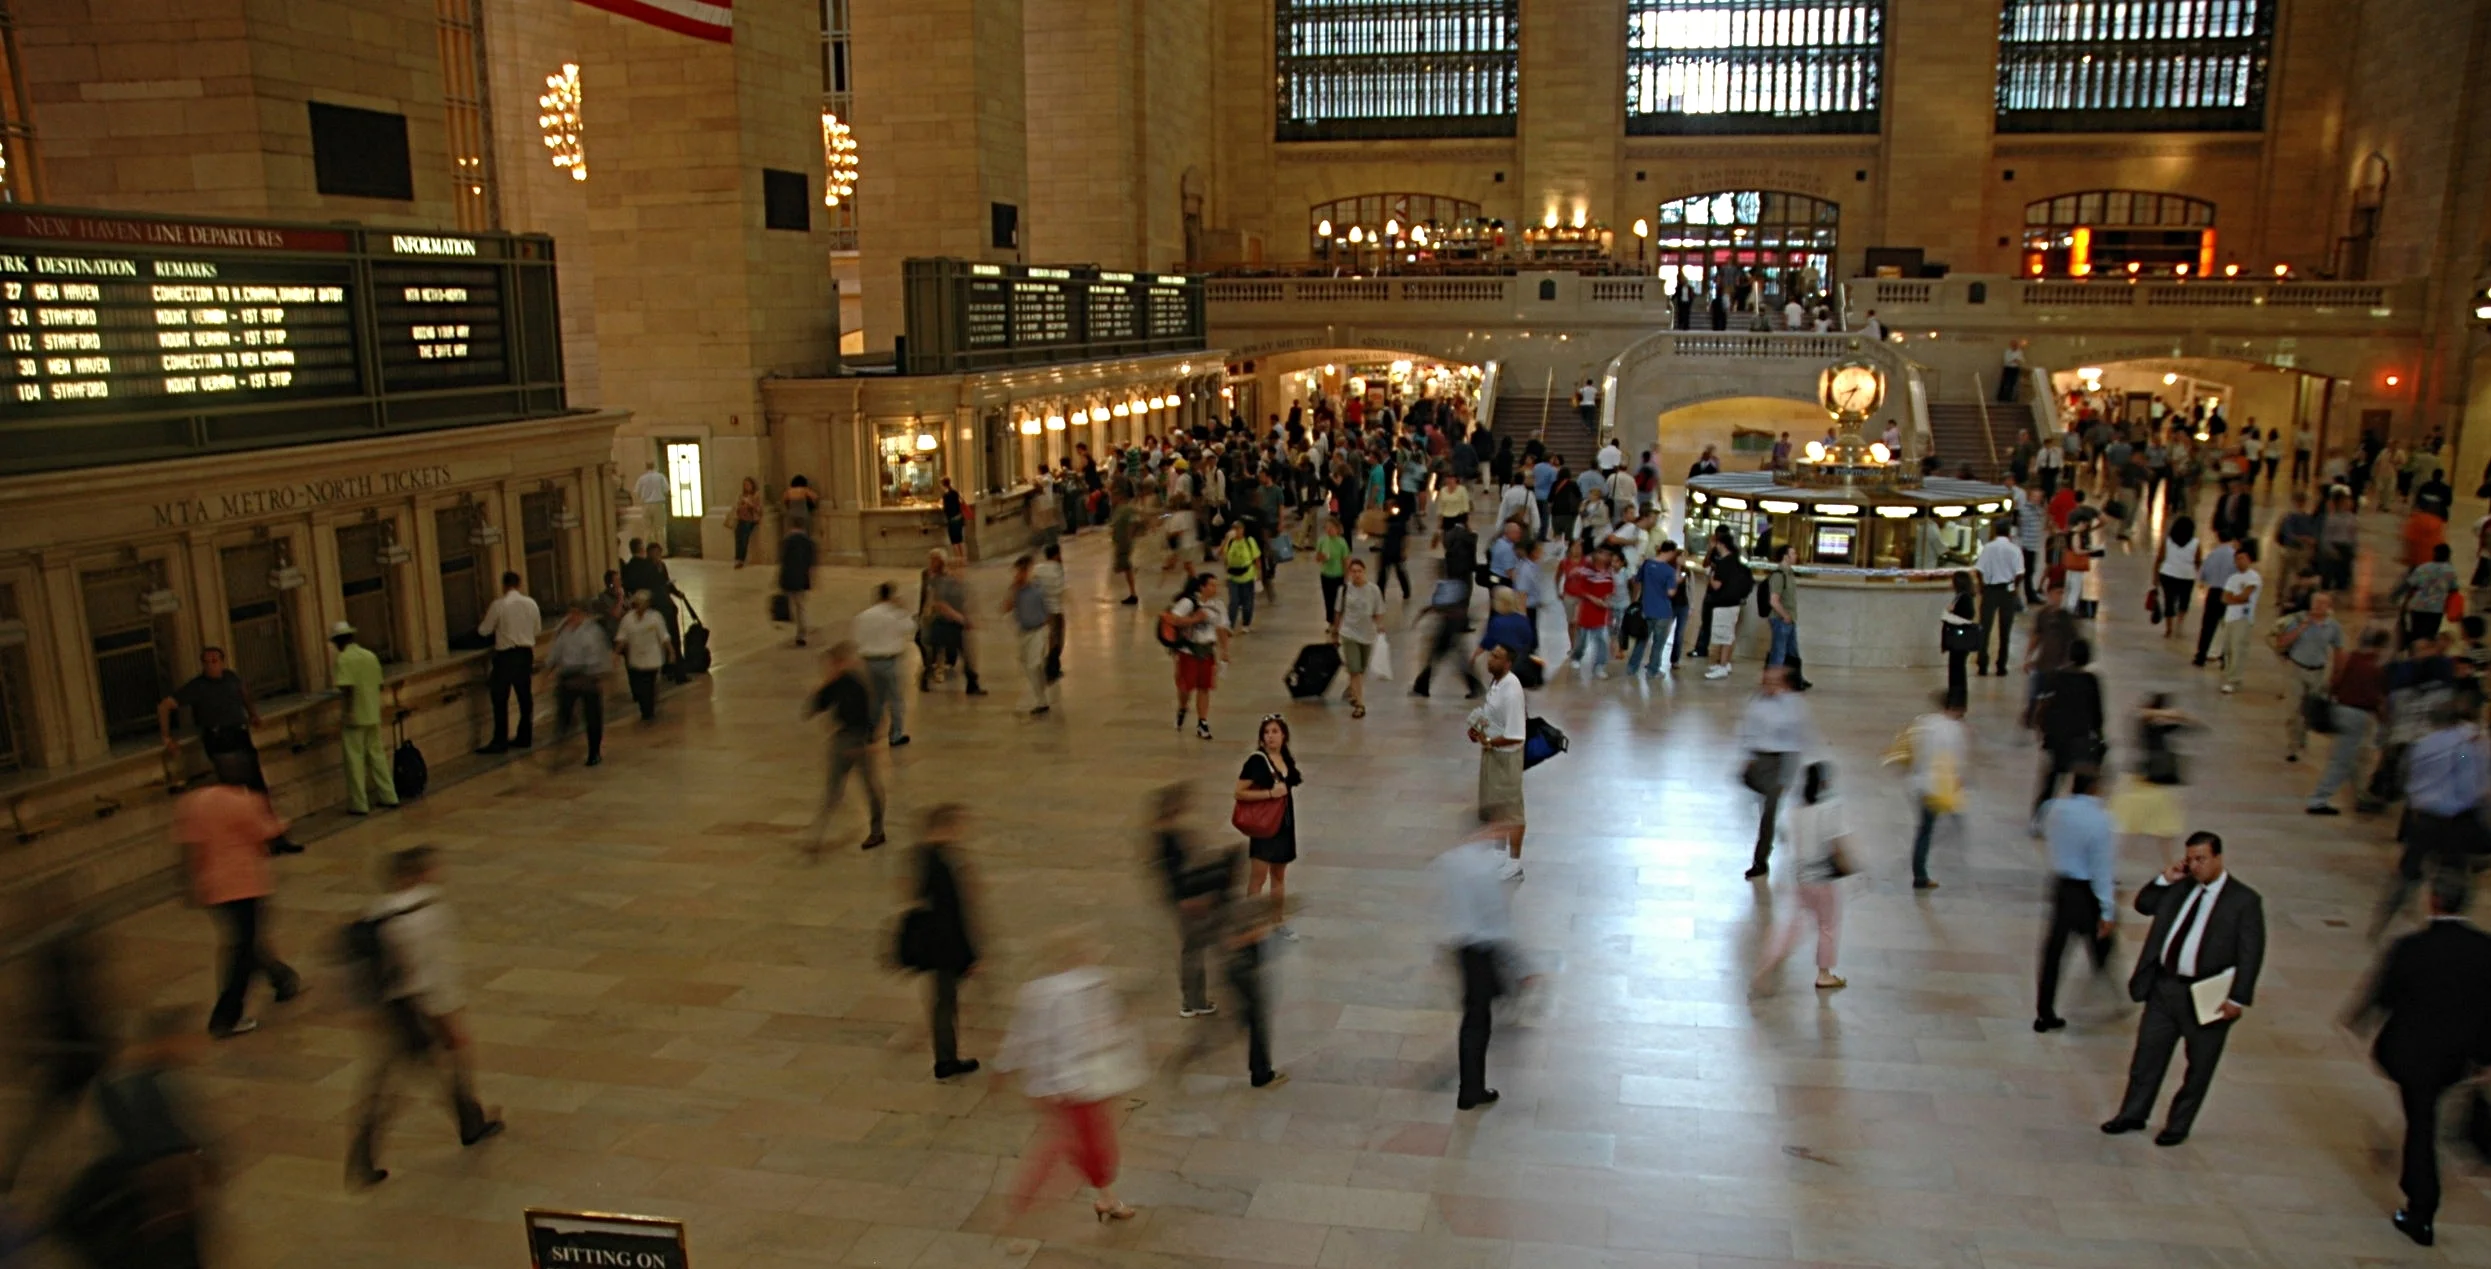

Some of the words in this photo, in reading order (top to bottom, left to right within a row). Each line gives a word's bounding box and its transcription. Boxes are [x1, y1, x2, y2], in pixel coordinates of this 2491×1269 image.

[25, 215, 72, 236] NEW
[79, 218, 142, 240] HAVEN
[146, 222, 186, 244] LINE
[189, 225, 284, 248] DEPARTURES
[392, 234, 476, 256] INFORMATION
[35, 255, 137, 277] DESTINATION
[154, 261, 218, 278] REMARKS
[4, 282, 22, 300] 27
[33, 283, 59, 301] NEW
[62, 283, 100, 301] HAVEN
[215, 286, 230, 302] TO
[9, 308, 28, 326] 24
[37, 308, 97, 326] STAMFORD
[155, 309, 187, 325] MOUNT
[241, 309, 258, 324] 1ST
[260, 308, 284, 323] STOP
[8, 333, 32, 351] 112
[41, 333, 101, 350] STAMFORD
[158, 332, 190, 348] MOUNT
[244, 330, 261, 345] 1ST
[263, 329, 287, 345] STOP
[17, 359, 37, 376] 30
[46, 358, 71, 375] NEW
[74, 356, 111, 374] HAVEN
[162, 353, 223, 370] CONNECTION
[224, 352, 239, 368] TO
[17, 384, 41, 401] 104
[50, 381, 109, 399] STAMFORD
[165, 376, 197, 393] MOUNT
[249, 373, 266, 388] 1ST
[268, 371, 292, 387] STOP
[152, 501, 210, 529] MTA
[221, 474, 373, 519] METRO-NORTH
[381, 463, 452, 494] TICKETS
[552, 1245, 632, 1267] SITTING
[636, 1252, 666, 1269] ON
